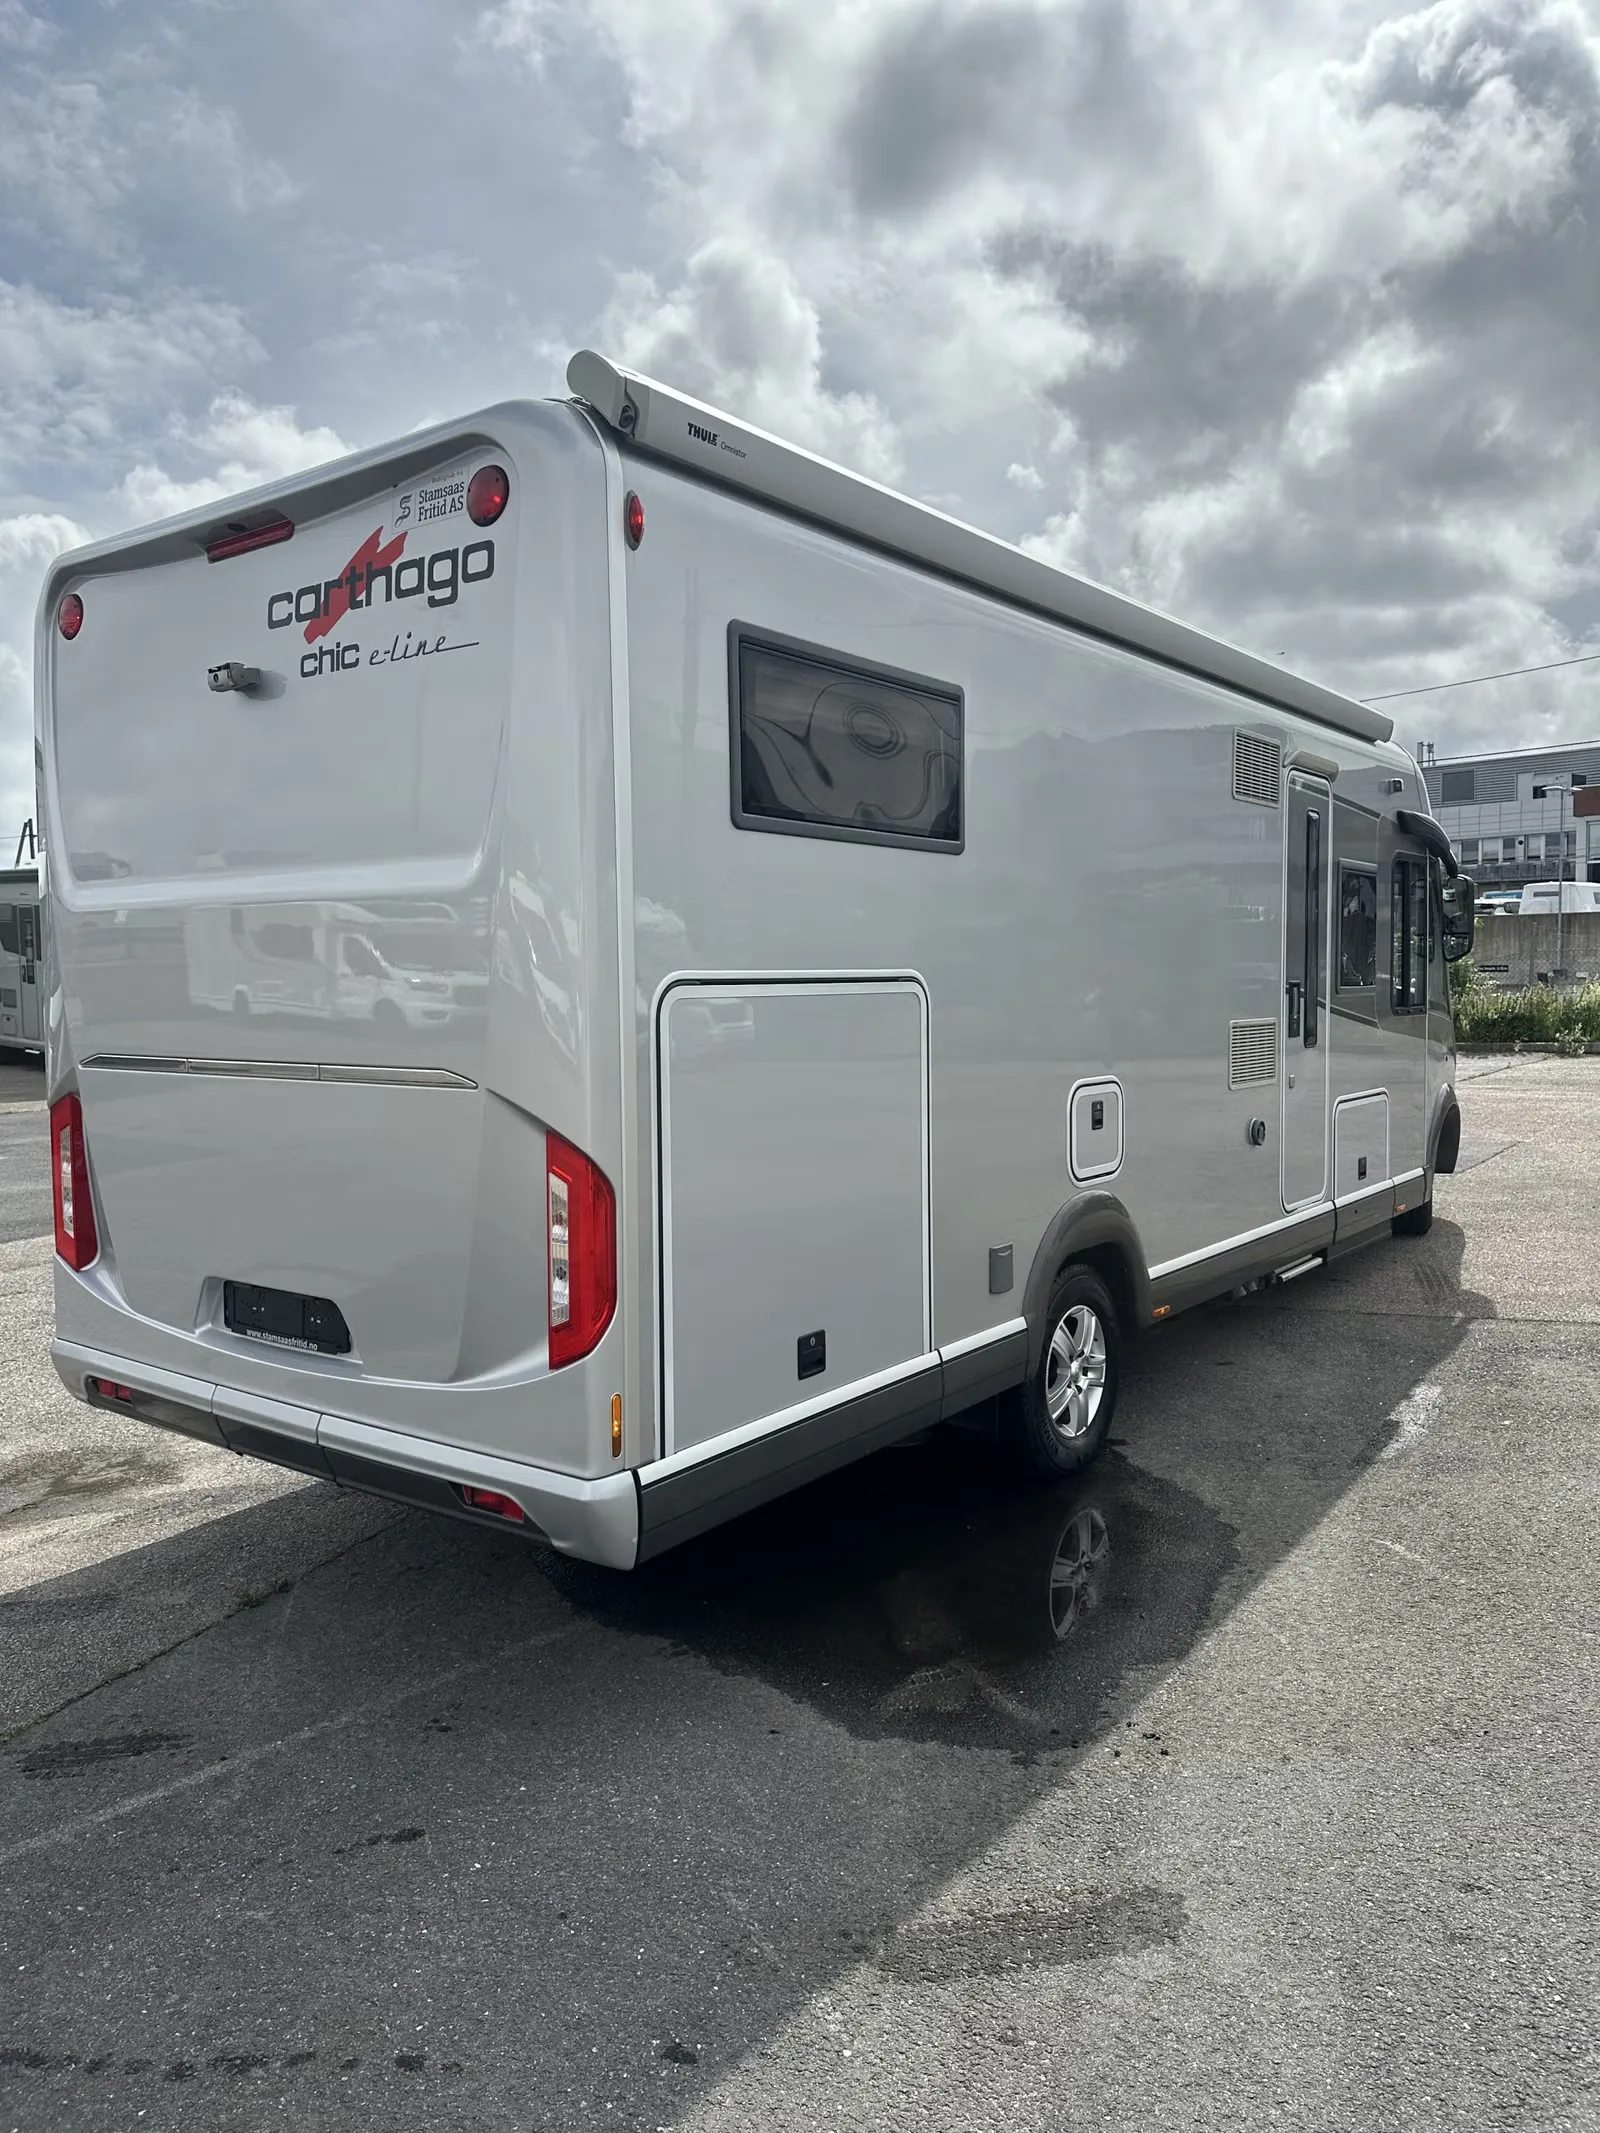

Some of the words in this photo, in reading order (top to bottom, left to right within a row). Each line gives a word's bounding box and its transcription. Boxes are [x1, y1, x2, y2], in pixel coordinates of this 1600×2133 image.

[687, 422, 718, 447] THULE
[720, 441, 747, 459] Omnistor
[417, 499, 447, 522] Fritid
[448, 494, 464, 514] AS
[418, 481, 465, 505] Stamsaas
[267, 539, 495, 630] carthago
[300, 641, 360, 679] chic
[246, 1328, 318, 1351] www.stamsaasfritid.no
